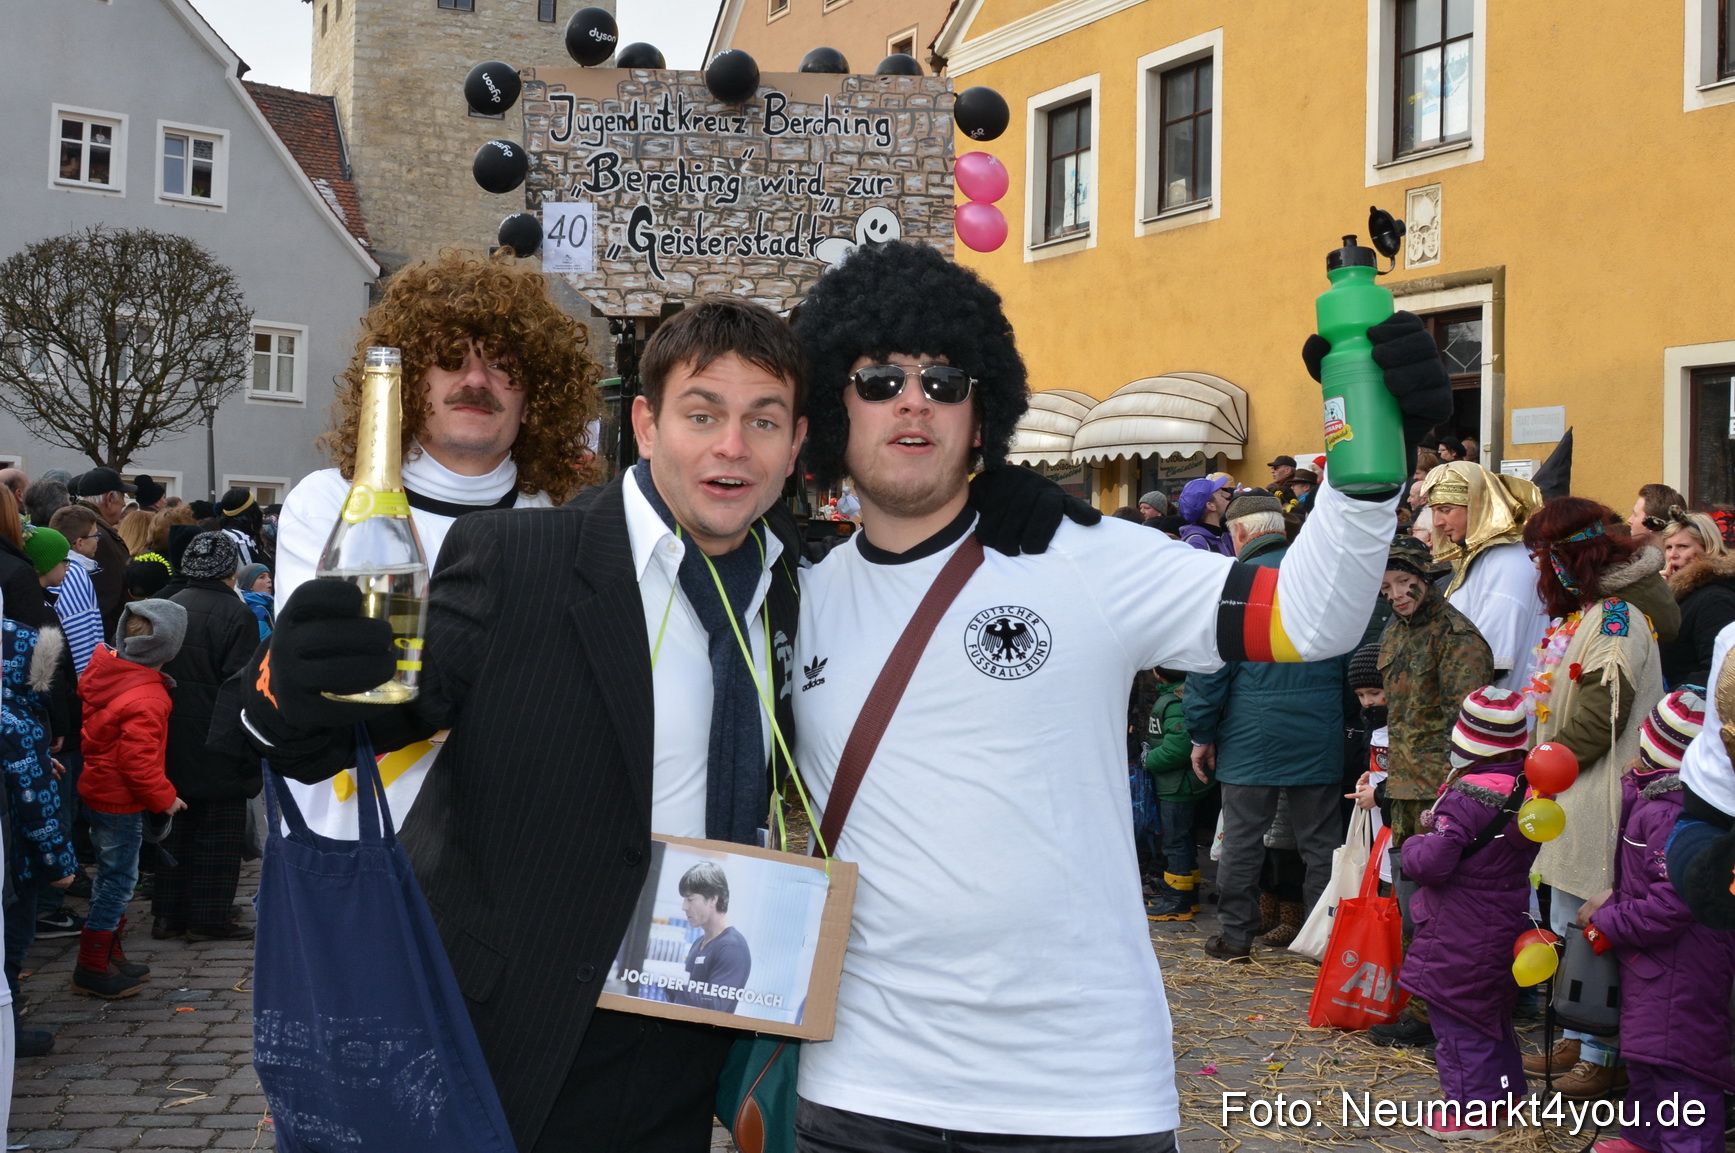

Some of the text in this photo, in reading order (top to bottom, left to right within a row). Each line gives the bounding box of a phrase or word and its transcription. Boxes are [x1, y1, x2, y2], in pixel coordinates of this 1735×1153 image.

[588, 26, 617, 43] dyson
[481, 72, 501, 103] dyson
[762, 92, 892, 147] Berching
[759, 161, 825, 197] wird
[847, 175, 892, 196] zur
[547, 213, 588, 248] 40
[969, 606, 1040, 631] DEUTSCHER
[968, 640, 1048, 677] FUSSBALL-BUND
[802, 678, 825, 692] adidas
[621, 968, 784, 1008] JOGI DER PFLEGECOACH
